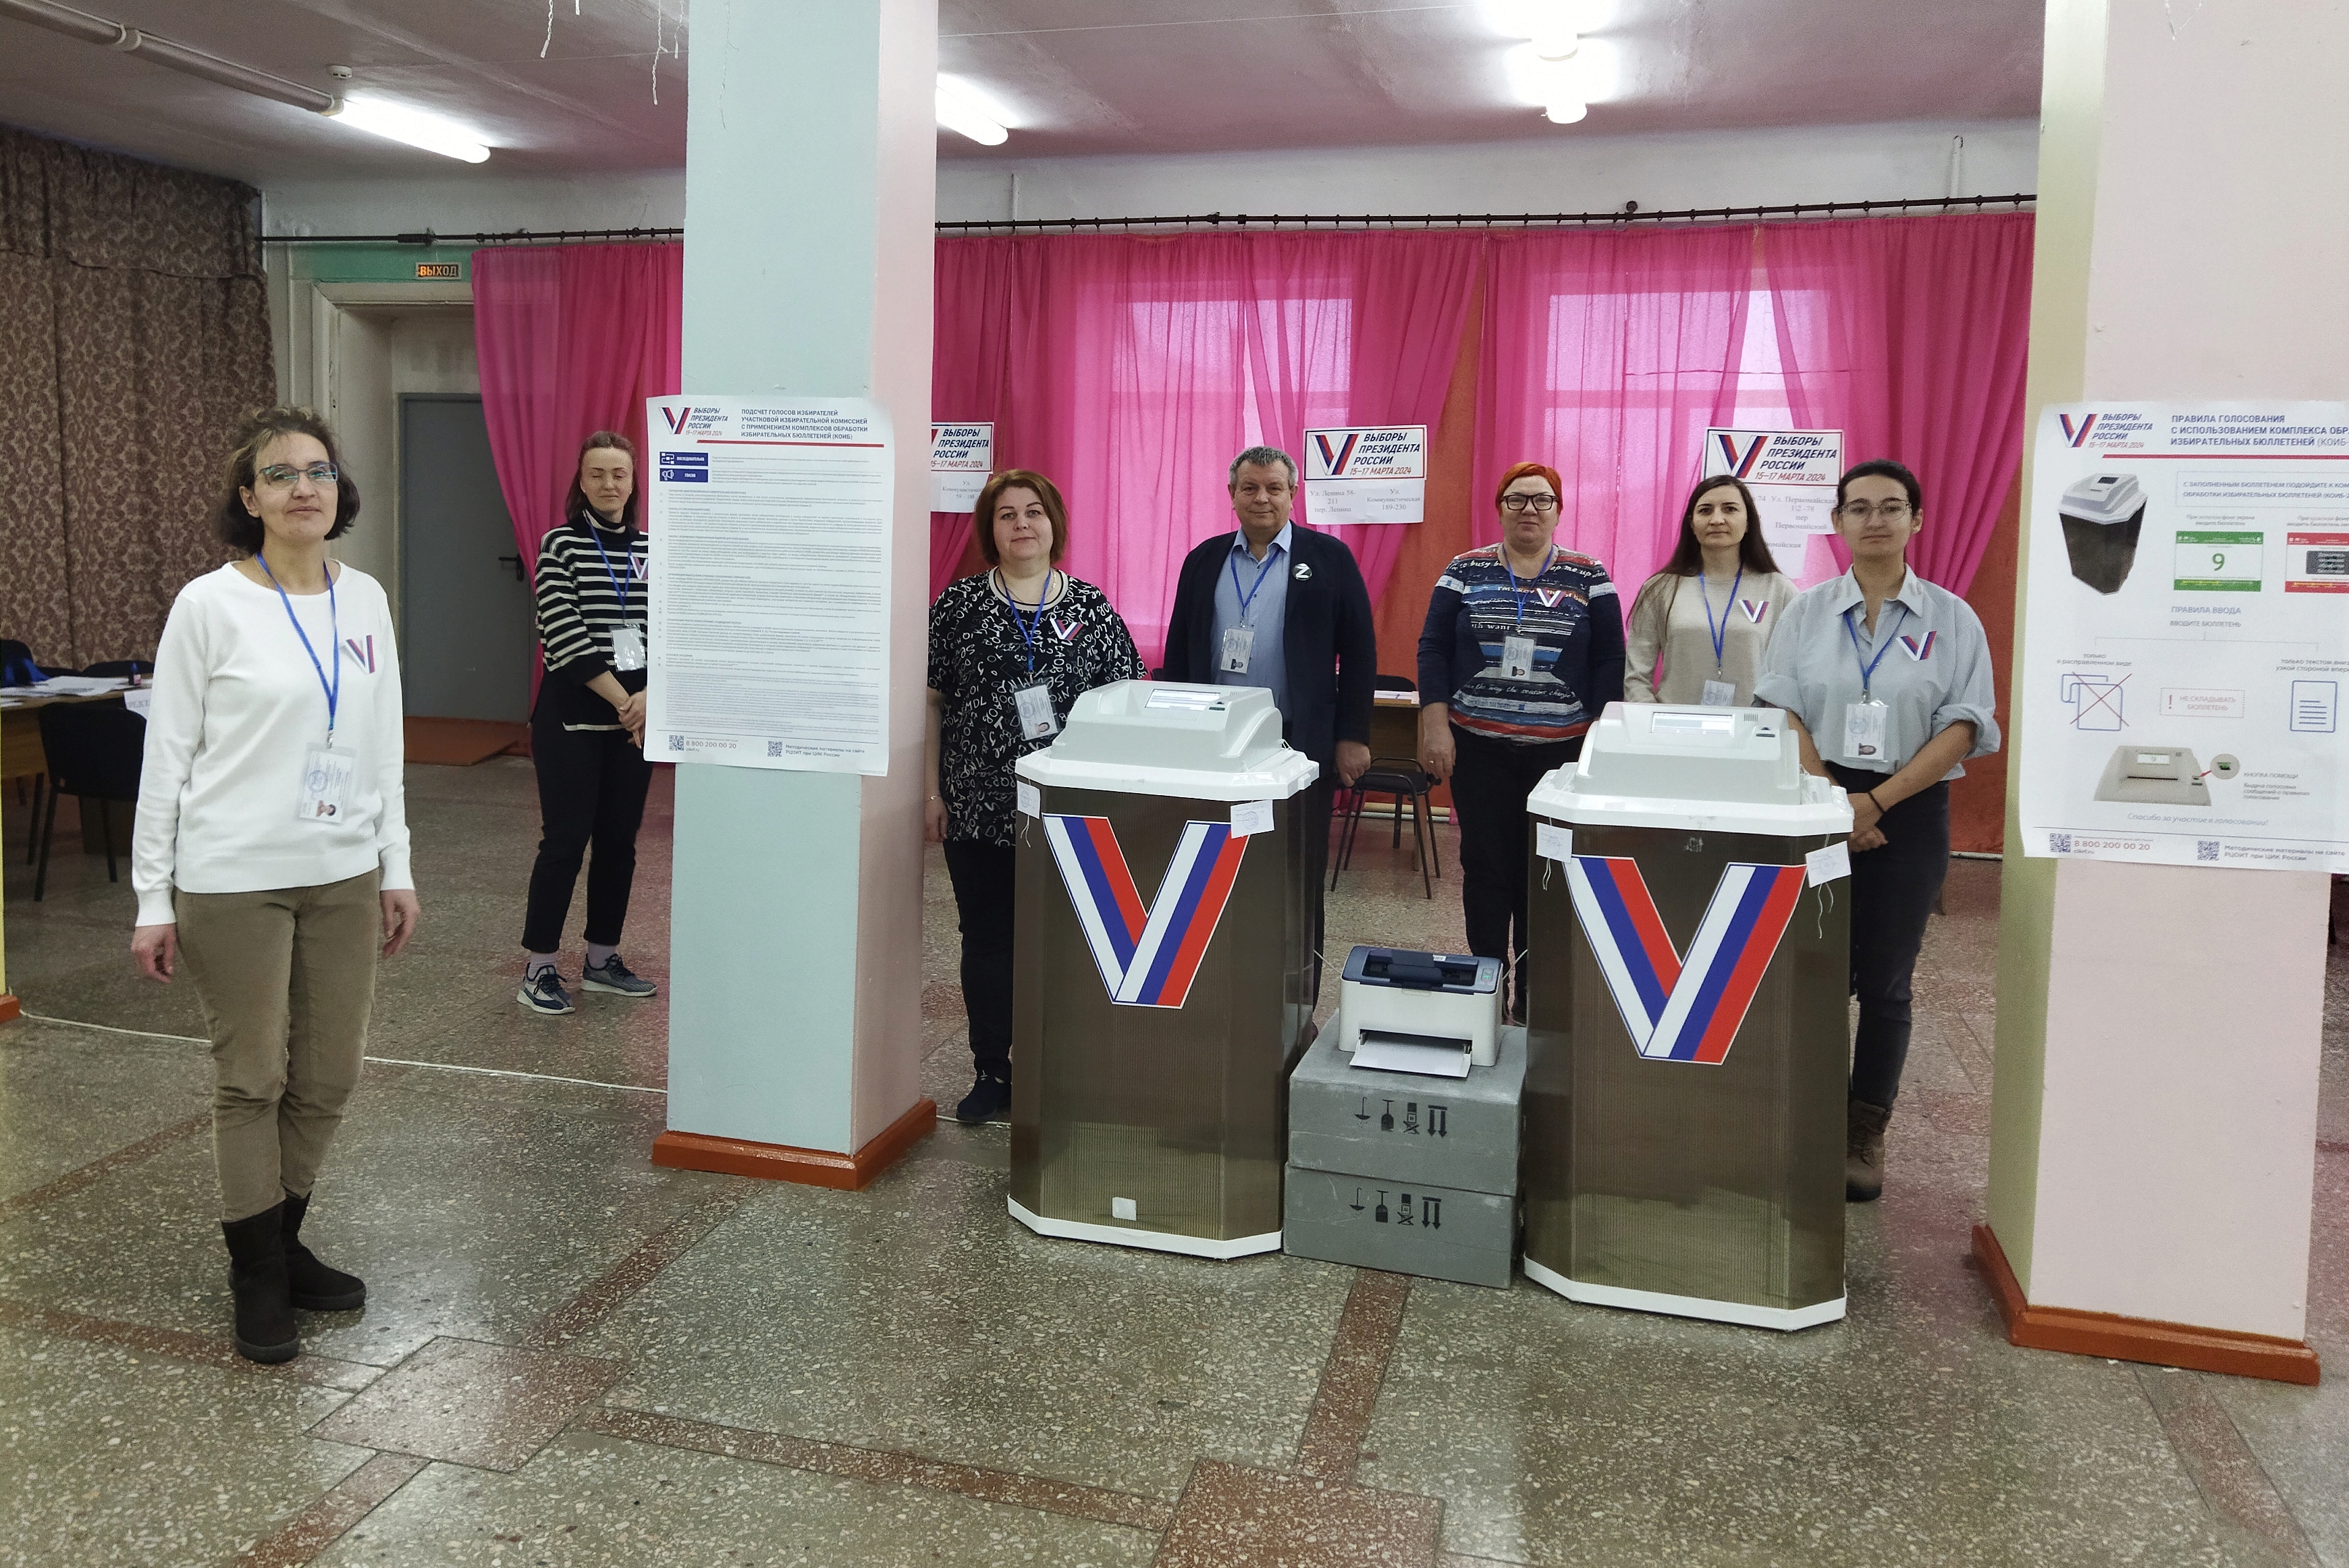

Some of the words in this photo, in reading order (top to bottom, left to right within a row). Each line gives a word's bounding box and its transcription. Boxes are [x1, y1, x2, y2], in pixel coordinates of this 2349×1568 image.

[420, 265, 457, 277] ВЫХОД
[942, 429, 980, 437] ВЫБОРЫ
[1364, 433, 1407, 442] ВЫБОРЫ
[938, 439, 989, 448] ПРЕЗИДЕНТА
[1773, 436, 1823, 446] ВЫБОРЫ
[2253, 437, 2315, 445] БЮЛЛЕТЕНЕЙ
[1358, 443, 1420, 454] ПРЕЗИДЕНТА
[1766, 448, 1837, 459] ПРЕЗИДЕНТА
[1353, 456, 1394, 465] РОССИИ
[1760, 460, 1806, 470] РОССИИ
[1806, 473, 1826, 481] 2024
[2213, 553, 2225, 571] 9
[2213, 607, 2241, 615] ВВОДА
[2128, 813, 2161, 821] Спасибо
